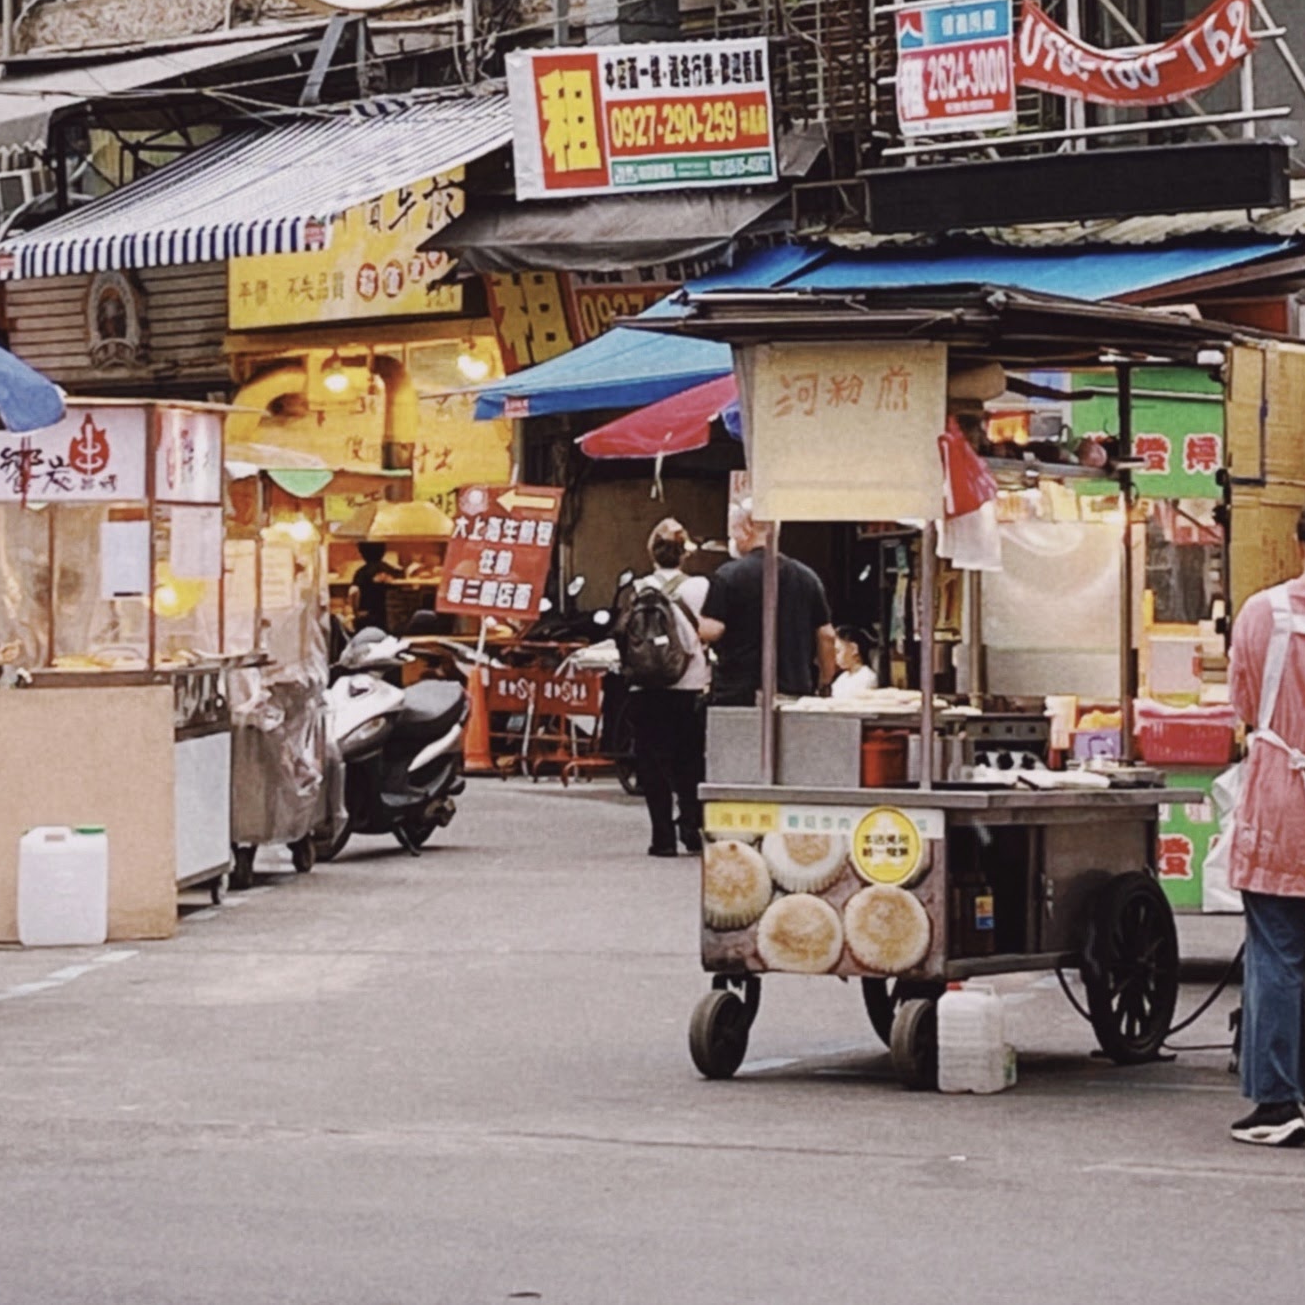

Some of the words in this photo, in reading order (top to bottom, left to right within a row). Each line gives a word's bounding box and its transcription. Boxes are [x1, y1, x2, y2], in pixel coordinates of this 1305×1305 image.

[539, 69, 601, 173] 租
[610, 101, 737, 149] 0927-290-259
[491, 270, 573, 366] 租
